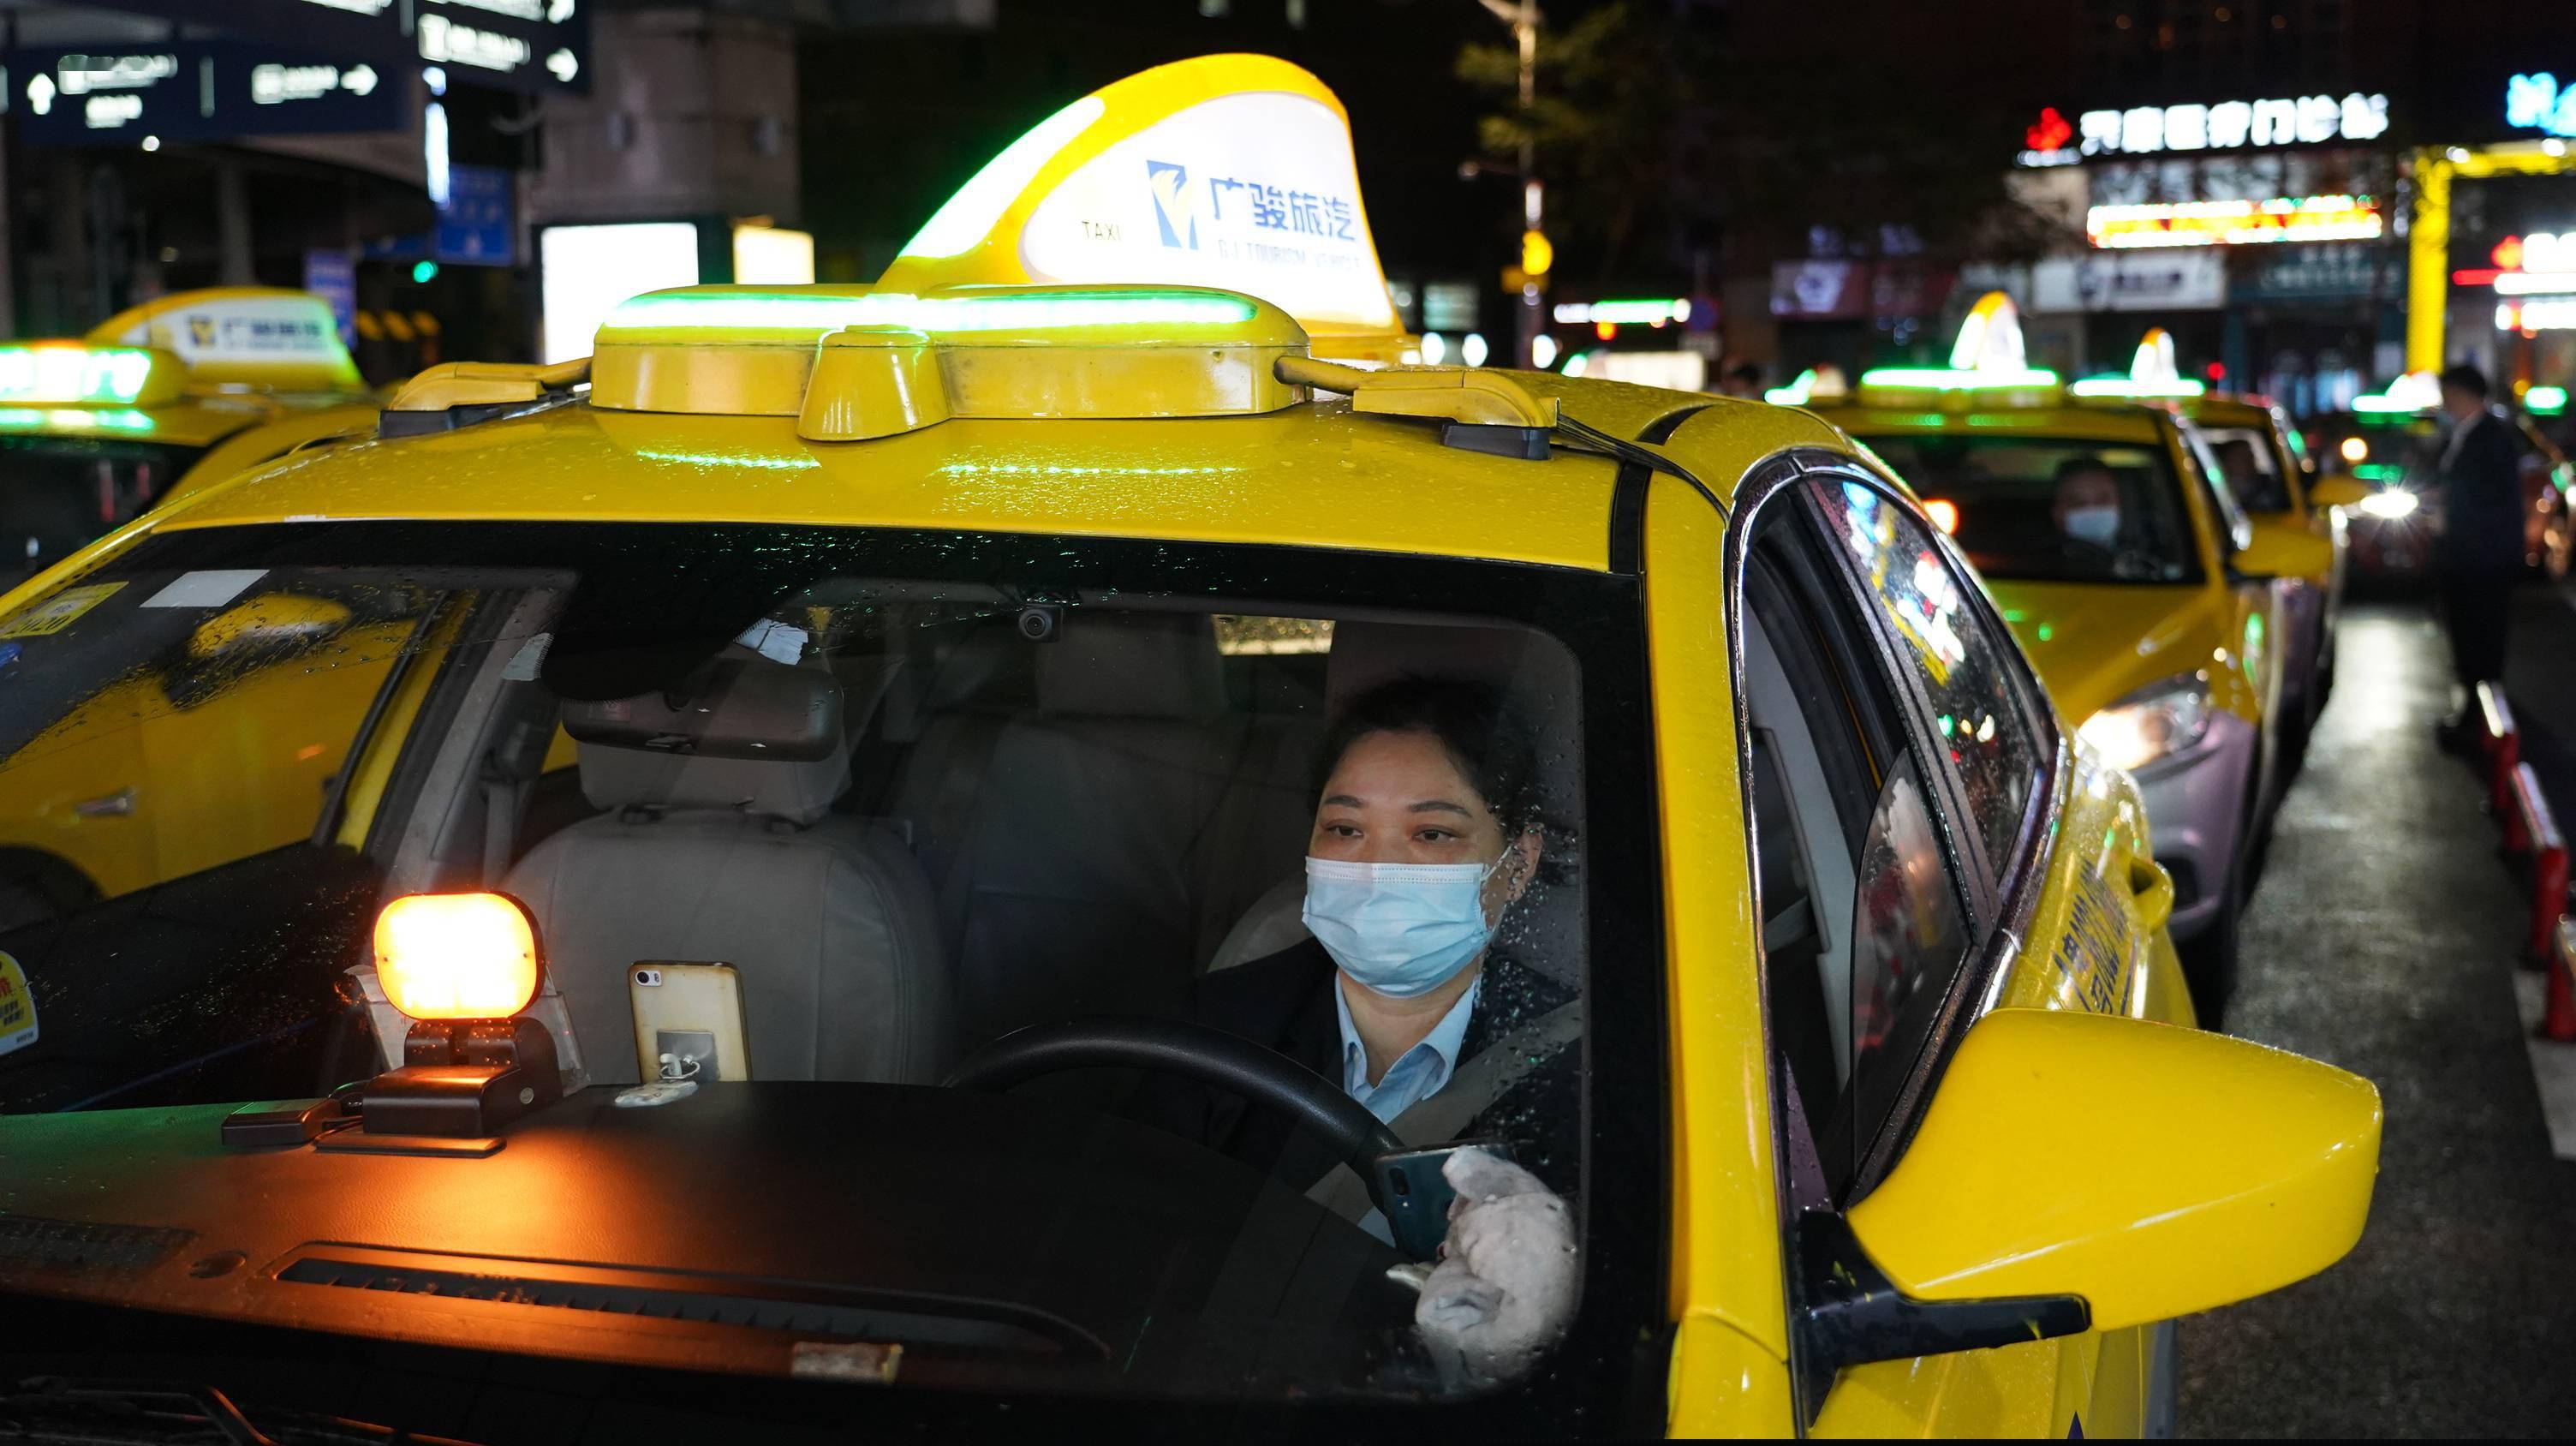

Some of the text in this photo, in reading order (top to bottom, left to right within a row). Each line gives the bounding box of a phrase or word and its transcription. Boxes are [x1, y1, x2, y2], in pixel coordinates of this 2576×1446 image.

[1081, 220, 1122, 242] TAXI
[1209, 177, 1356, 242] 广骏旅汽
